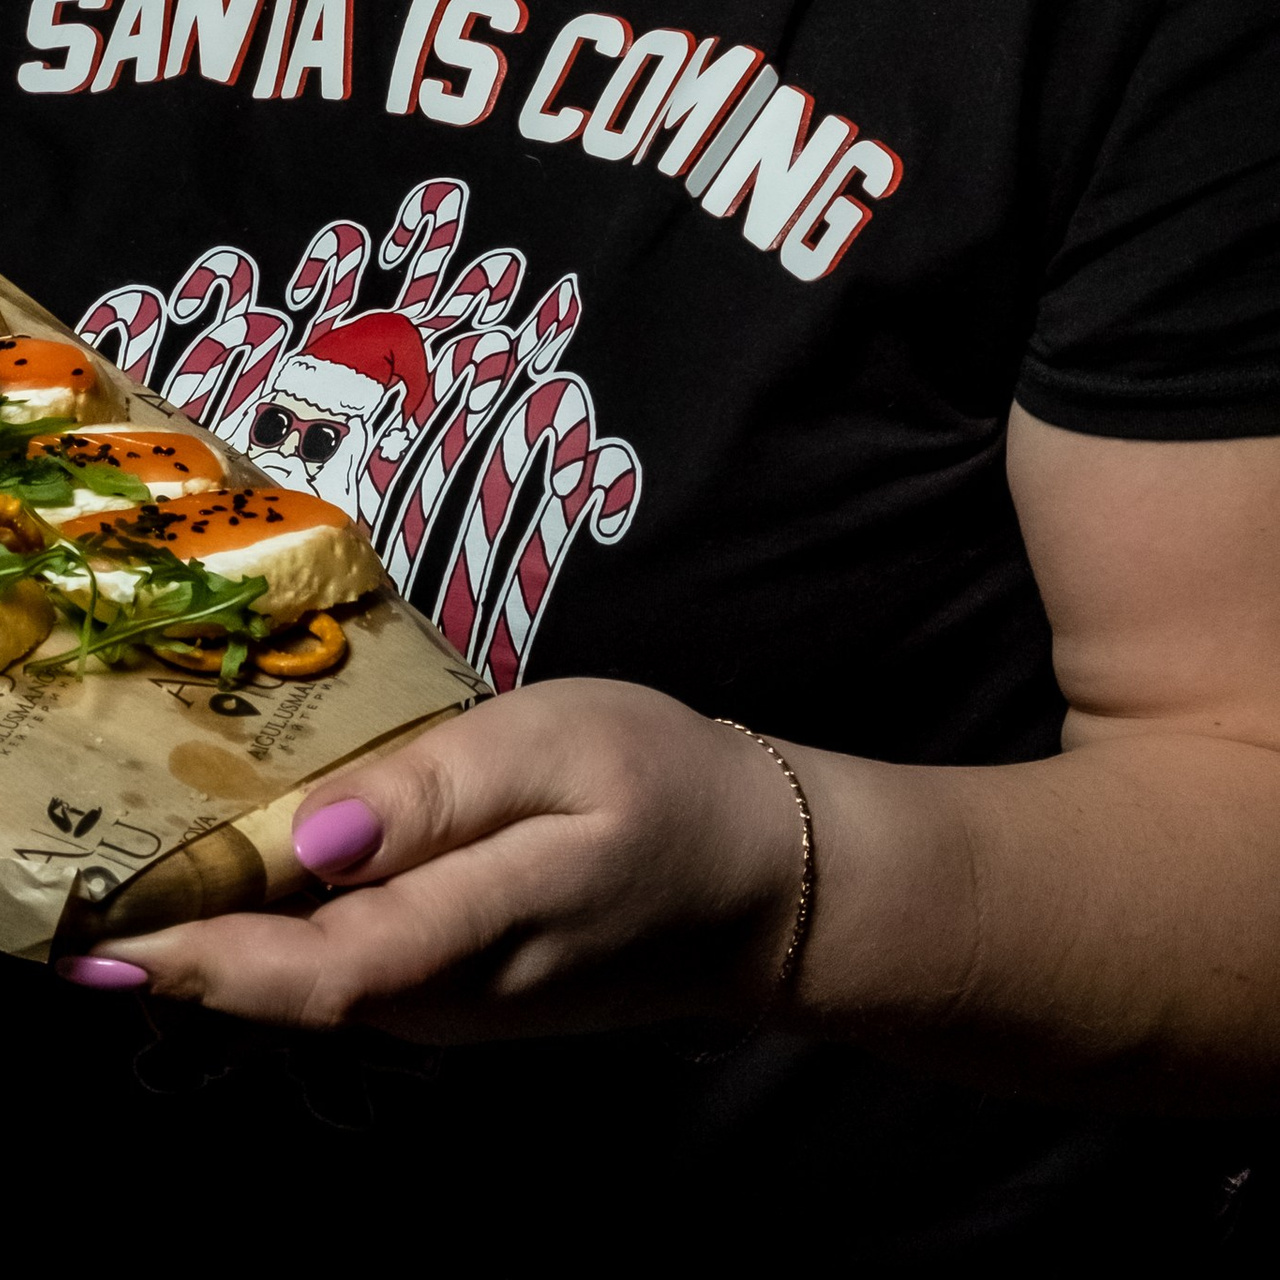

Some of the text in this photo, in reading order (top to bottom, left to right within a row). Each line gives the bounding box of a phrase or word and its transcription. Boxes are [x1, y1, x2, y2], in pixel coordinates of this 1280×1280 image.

[519, 12, 904, 283] COMING
[148, 678, 219, 708] A
[97, 819, 161, 859] U
